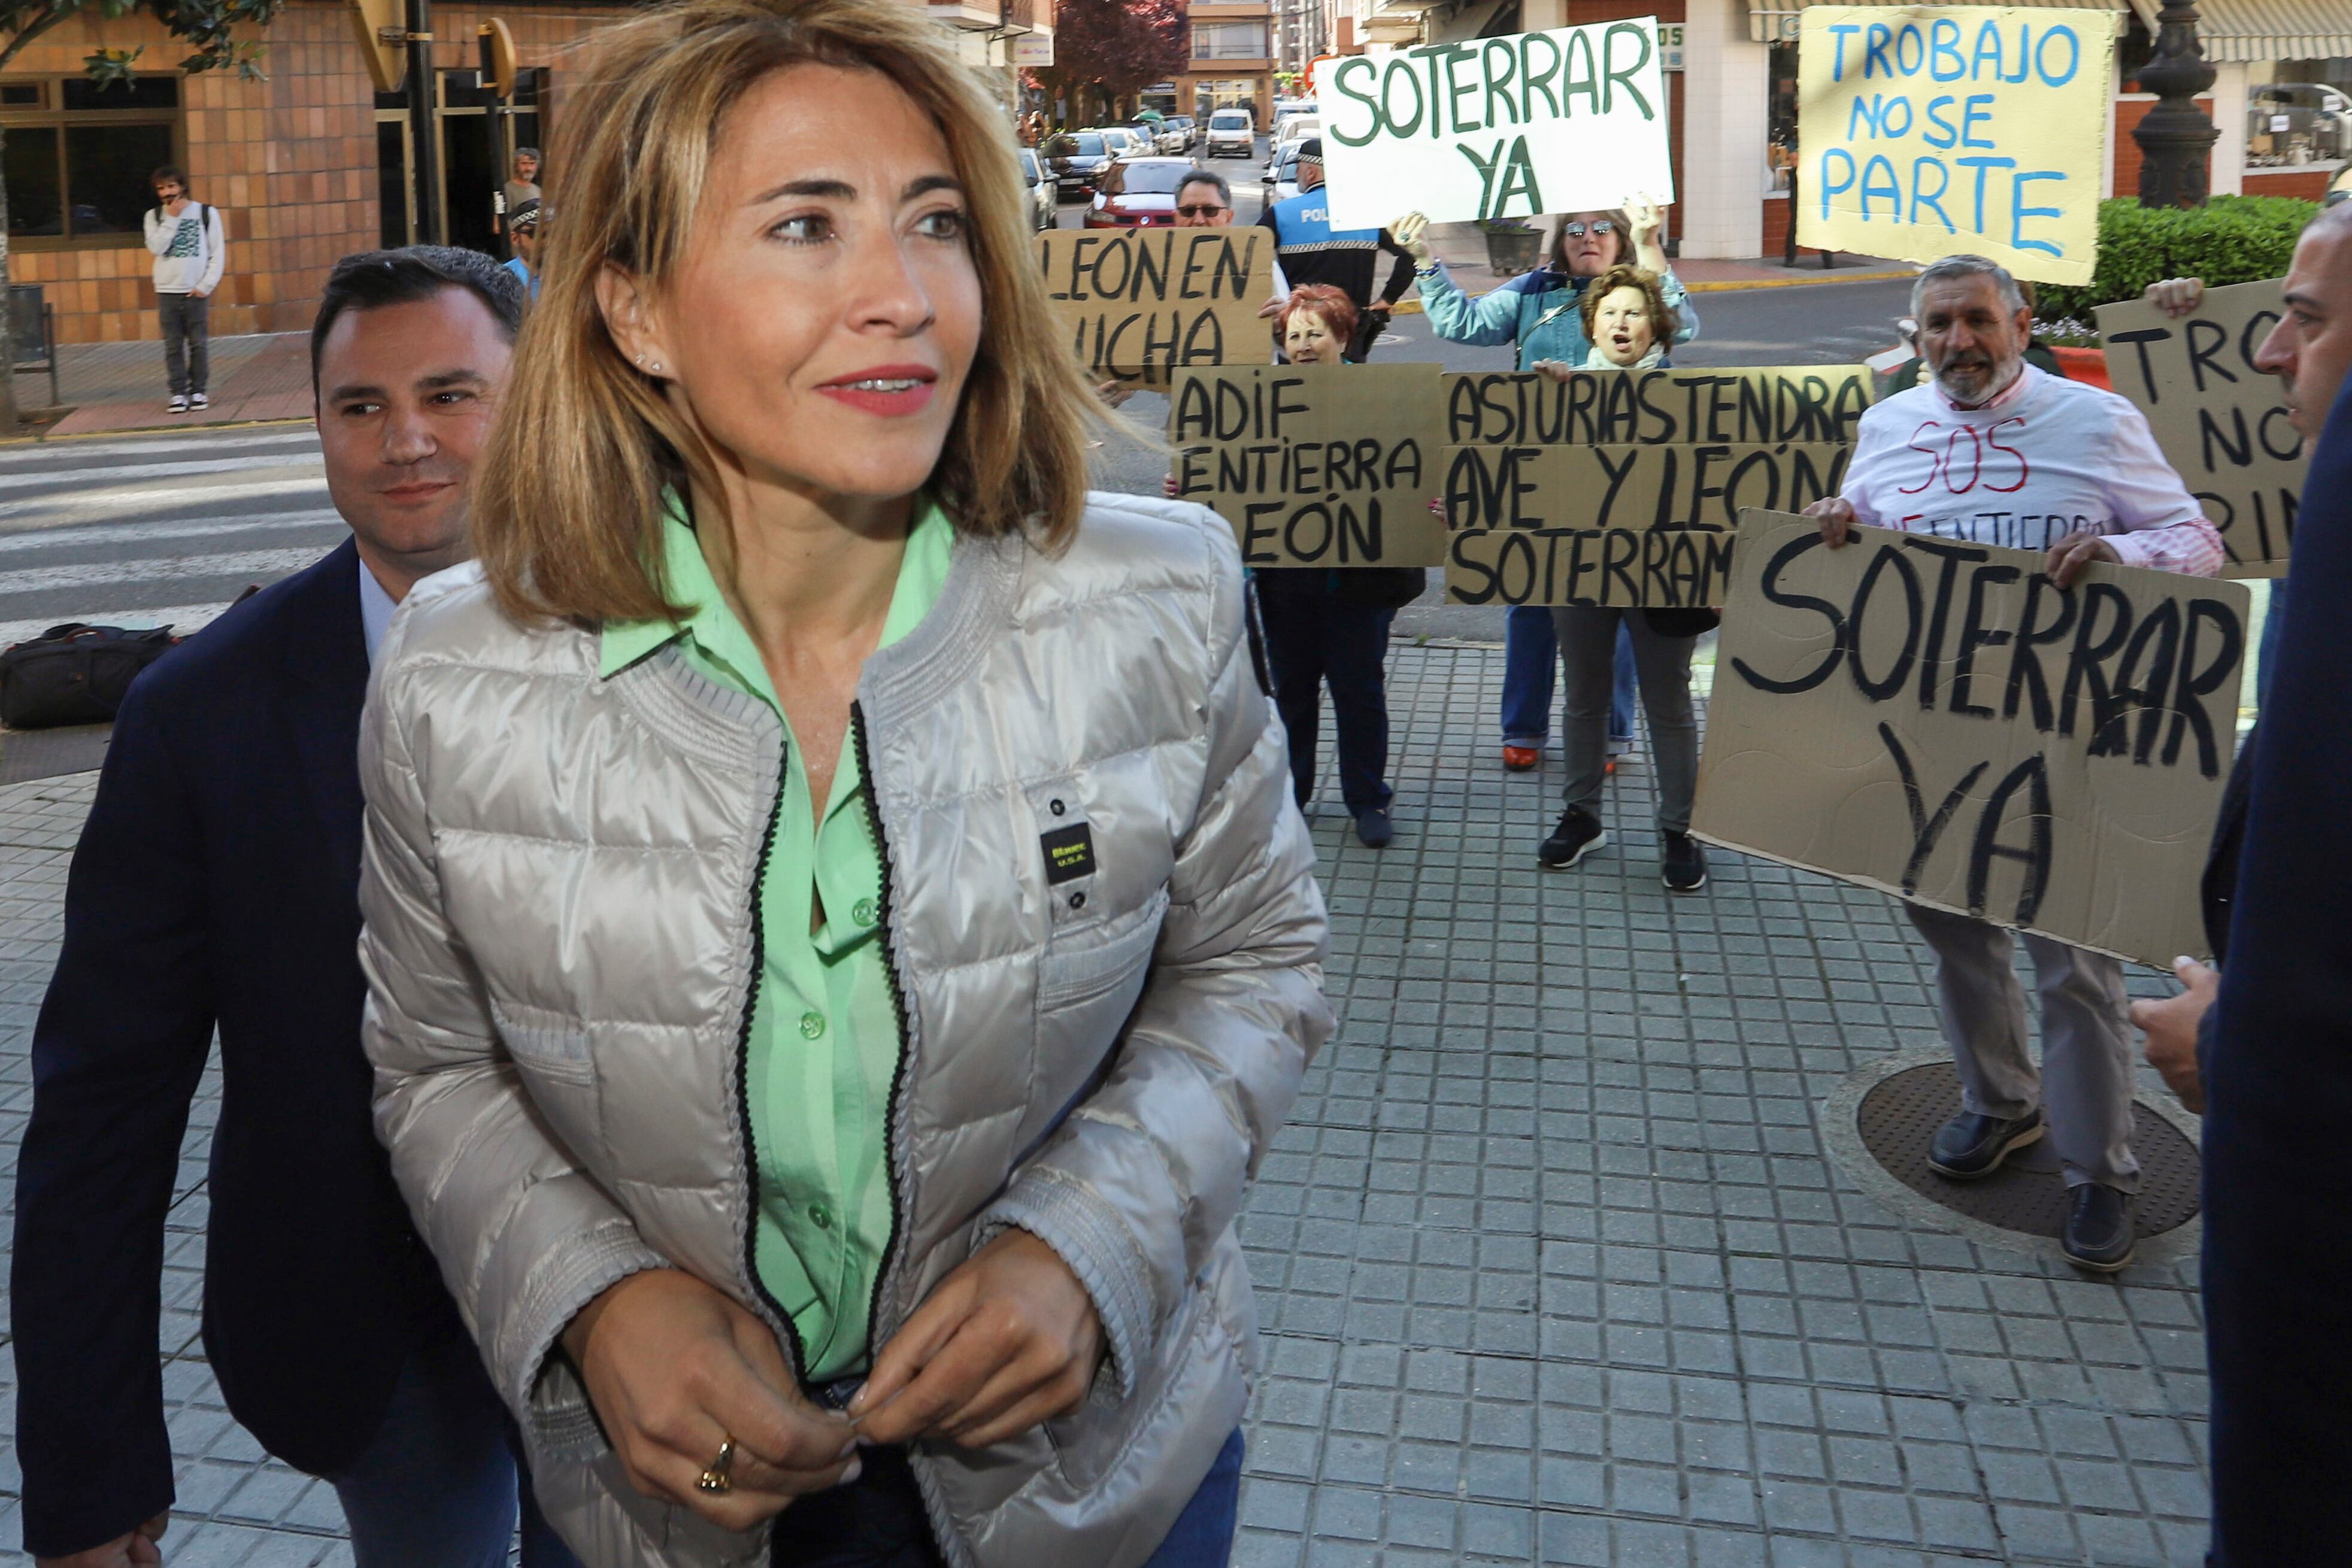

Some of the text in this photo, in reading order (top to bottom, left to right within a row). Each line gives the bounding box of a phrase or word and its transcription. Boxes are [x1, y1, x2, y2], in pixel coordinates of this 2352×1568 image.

[1330, 23, 1654, 147] SOTERRAR
[1829, 19, 2080, 87] TROBAJO
[1848, 93, 1995, 149] NO SE
[1456, 135, 1543, 220] YA
[1821, 148, 2068, 257] PARTE
[1042, 229, 1257, 302] LEÓN EN
[1075, 307, 1223, 384] UCHA
[1449, 371, 1678, 445] ASTURIAS
[2200, 407, 2304, 472] NO
[1446, 443, 1848, 533] AVE Y LEÓN
[1898, 417, 2030, 495] SOS
[1207, 493, 1382, 563] EÓN
[1732, 530, 2241, 780] SOTERRAR
[1878, 720, 2053, 928] YA
